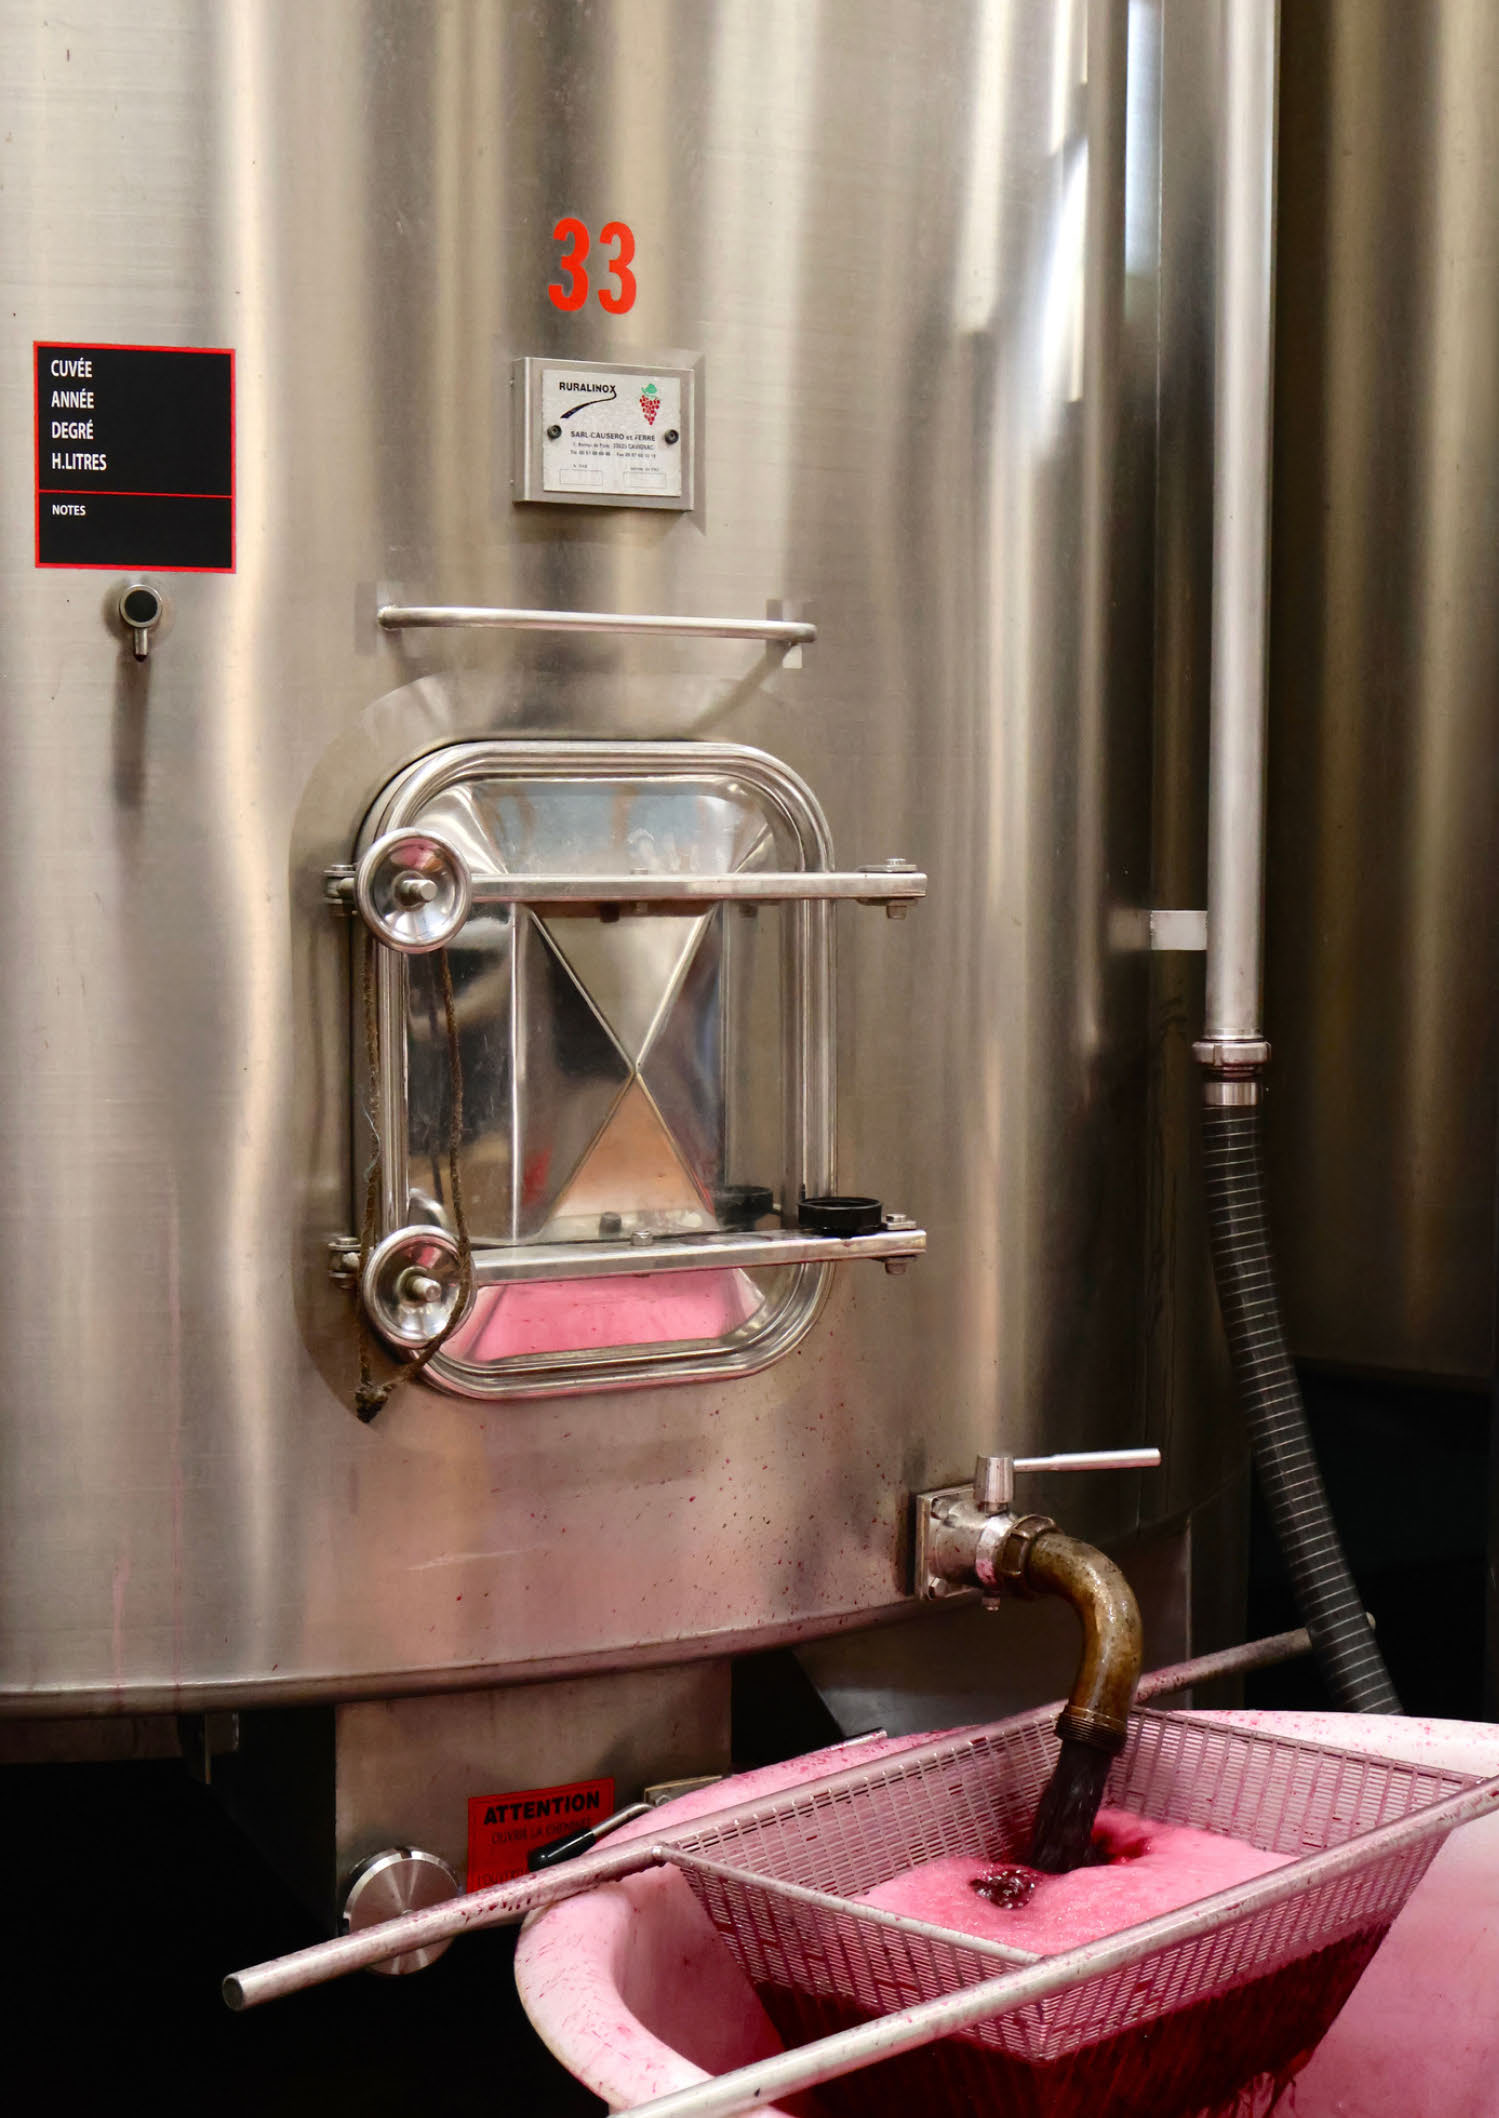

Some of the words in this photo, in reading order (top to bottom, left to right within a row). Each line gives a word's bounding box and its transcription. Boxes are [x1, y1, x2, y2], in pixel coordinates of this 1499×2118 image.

[548, 217, 637, 315] 33
[51, 357, 93, 378] CUVÉE
[559, 382, 616, 393] RURALINOX
[51, 388, 95, 409] ANNÉE
[51, 419, 94, 440] DEGRÉ
[51, 452, 107, 471] H.LITRES
[52, 504, 86, 516] NOTES
[484, 1790, 600, 1825] ATTENTION
